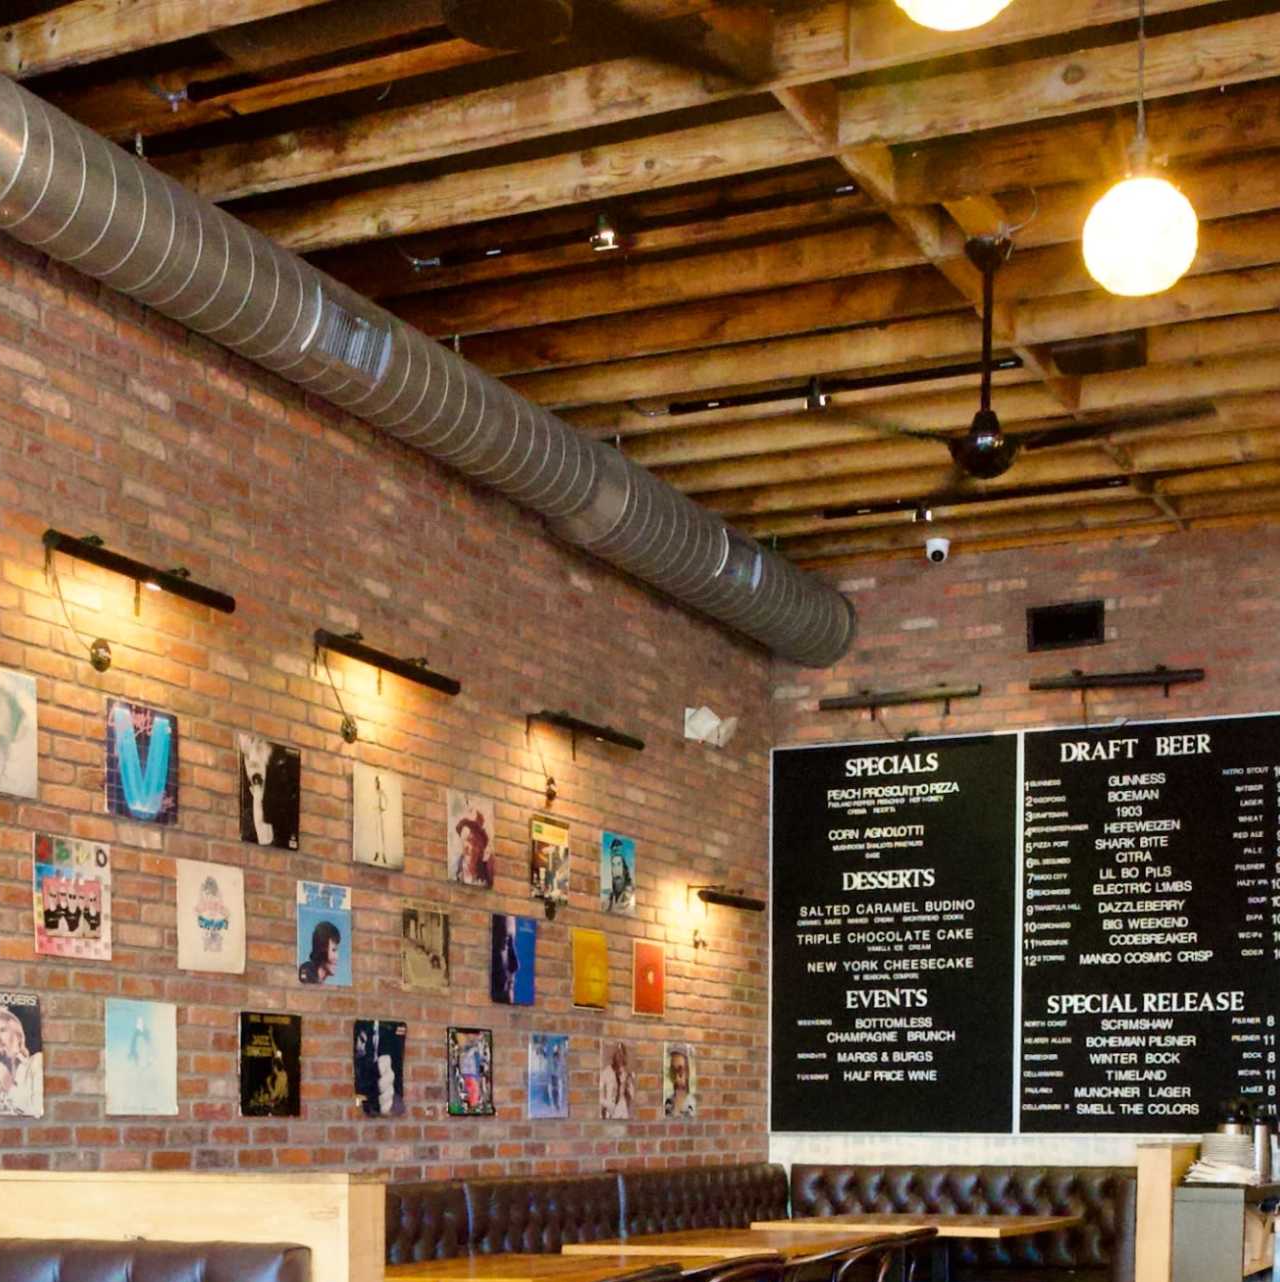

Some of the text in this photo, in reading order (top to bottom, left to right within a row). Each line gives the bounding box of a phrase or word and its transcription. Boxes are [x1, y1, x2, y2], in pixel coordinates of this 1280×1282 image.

[1060, 734, 1211, 763] DRAFT BEER
[845, 752, 939, 777] SPECIALS
[1108, 773, 1166, 787] GUINNESS
[1246, 766, 1269, 774] STOUT
[827, 788, 861, 801] PEACH
[930, 782, 960, 794] PIZZA
[1025, 796, 1033, 807] 2
[1107, 789, 1159, 803] BOEMAN
[1025, 811, 1033, 822] 3
[1115, 806, 1142, 818] 1903
[828, 825, 924, 841] CORN AGNOLOTTI
[1104, 819, 1180, 834] HEFEWEIZEN
[1025, 842, 1033, 853] 5
[1095, 837, 1135, 850] SHARK
[1026, 858, 1033, 869] 6
[1115, 851, 1152, 863] CITRA
[842, 869, 936, 891] DESSERTS
[1027, 873, 1034, 884] 7
[1099, 868, 1116, 879] LIL
[1121, 867, 1139, 878] BO
[1026, 889, 1034, 899] 8
[799, 899, 976, 917] SALTED CARAMEL BUDINO
[1026, 905, 1034, 916] 9
[1098, 900, 1186, 914] DAZZLEBERRY
[1024, 922, 1036, 933] 10
[1102, 919, 1123, 930] BIG
[1128, 917, 1188, 930] WEEKEND
[797, 928, 975, 945] TRIPLE CHOCOLATE CAKE
[1024, 939, 1034, 950] 11
[1109, 932, 1198, 946] CODEBREAKER
[807, 957, 975, 973] NEW YORK CHEESECAKE
[1024, 955, 1037, 966] 12
[1080, 953, 1121, 965] MANGO
[846, 988, 928, 1009] EVENTS
[1047, 991, 1245, 1014] SPECIAL RELEASE
[855, 1017, 933, 1029] BOTTOMLESS
[1101, 1018, 1173, 1031] SCRIMSHAW
[1266, 1015, 1275, 1027] 8
[826, 1030, 956, 1044] CHAMPAGNE BRUNCH
[1086, 1036, 1146, 1048] BOHEMIAN
[1149, 1035, 1196, 1047] PILSNER
[1263, 1035, 1275, 1046] 11
[837, 1051, 878, 1063] MARGS
[880, 1052, 889, 1062] &
[892, 1051, 934, 1063] BURGS
[1089, 1053, 1138, 1065] WINTER
[1145, 1053, 1181, 1064] BOCK
[1267, 1052, 1276, 1063] 8
[843, 1070, 872, 1082] HALF
[873, 1070, 904, 1081] PRICE
[907, 1070, 937, 1082] WINE
[1105, 1070, 1167, 1081] TIMELAND
[1265, 1070, 1276, 1080] 11
[1074, 1087, 1140, 1098] MUNCHNER
[1149, 1087, 1191, 1098] LAGER
[1267, 1085, 1276, 1096] 8
[1076, 1103, 1277, 1115] SMELL THE COLORS 11
